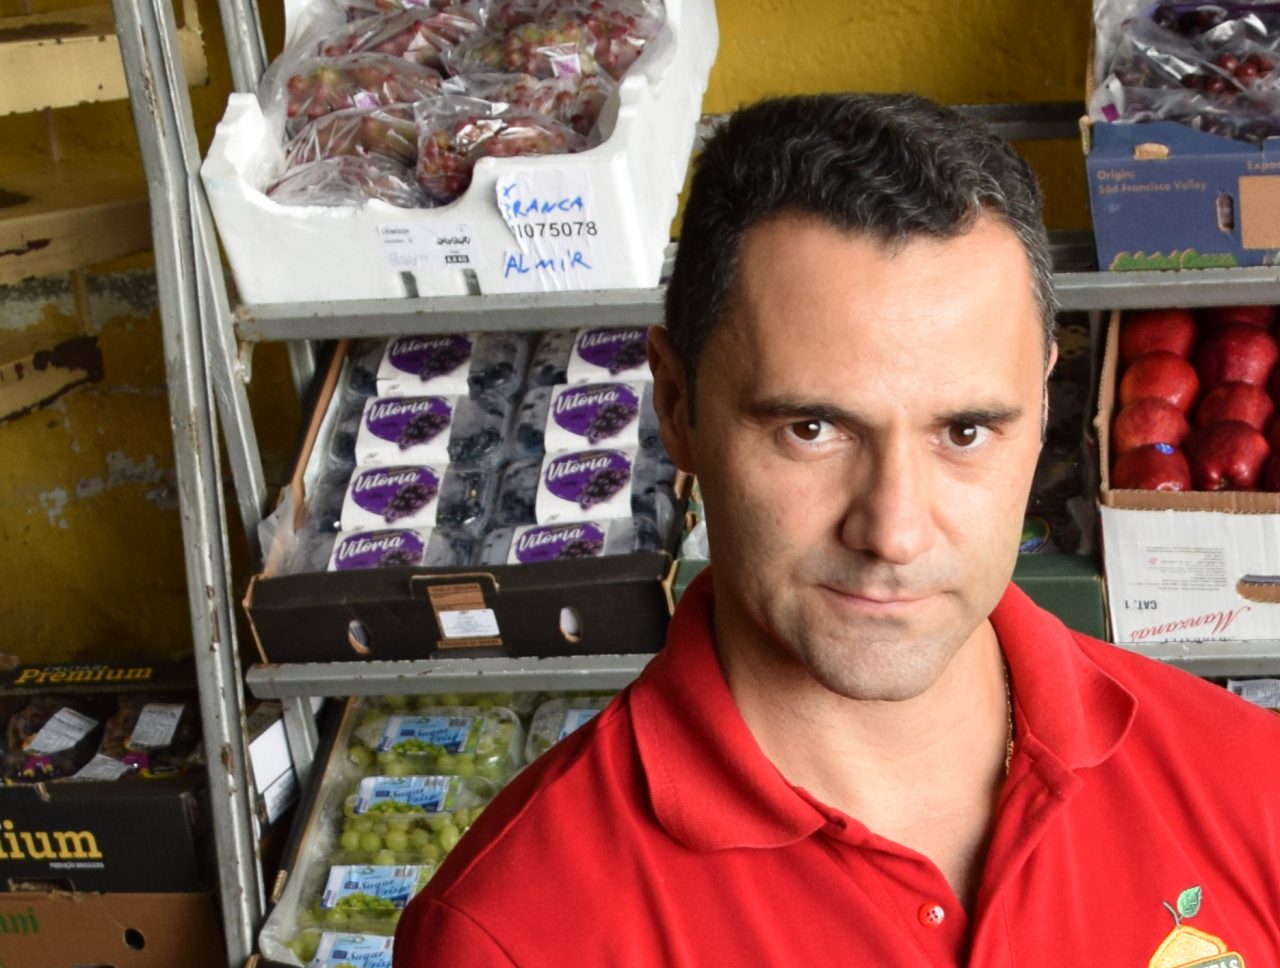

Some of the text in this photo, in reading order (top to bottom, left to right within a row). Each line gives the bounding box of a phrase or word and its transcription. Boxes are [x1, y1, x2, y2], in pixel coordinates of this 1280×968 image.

[392, 335, 452, 356] Vitoria
[580, 329, 641, 348] Vitoria
[368, 399, 432, 422] Vitoria
[556, 390, 620, 413] Vitoria
[548, 456, 612, 481] Vitoria
[355, 470, 420, 492] Vitoria
[340, 535, 404, 559] Vitoria
[519, 527, 585, 551] Vitoria
[1136, 600, 1158, 609] CAT.
[1130, 605, 1251, 639] Manzanas
[14, 667, 154, 685] Premium
[0, 819, 103, 860] ium
